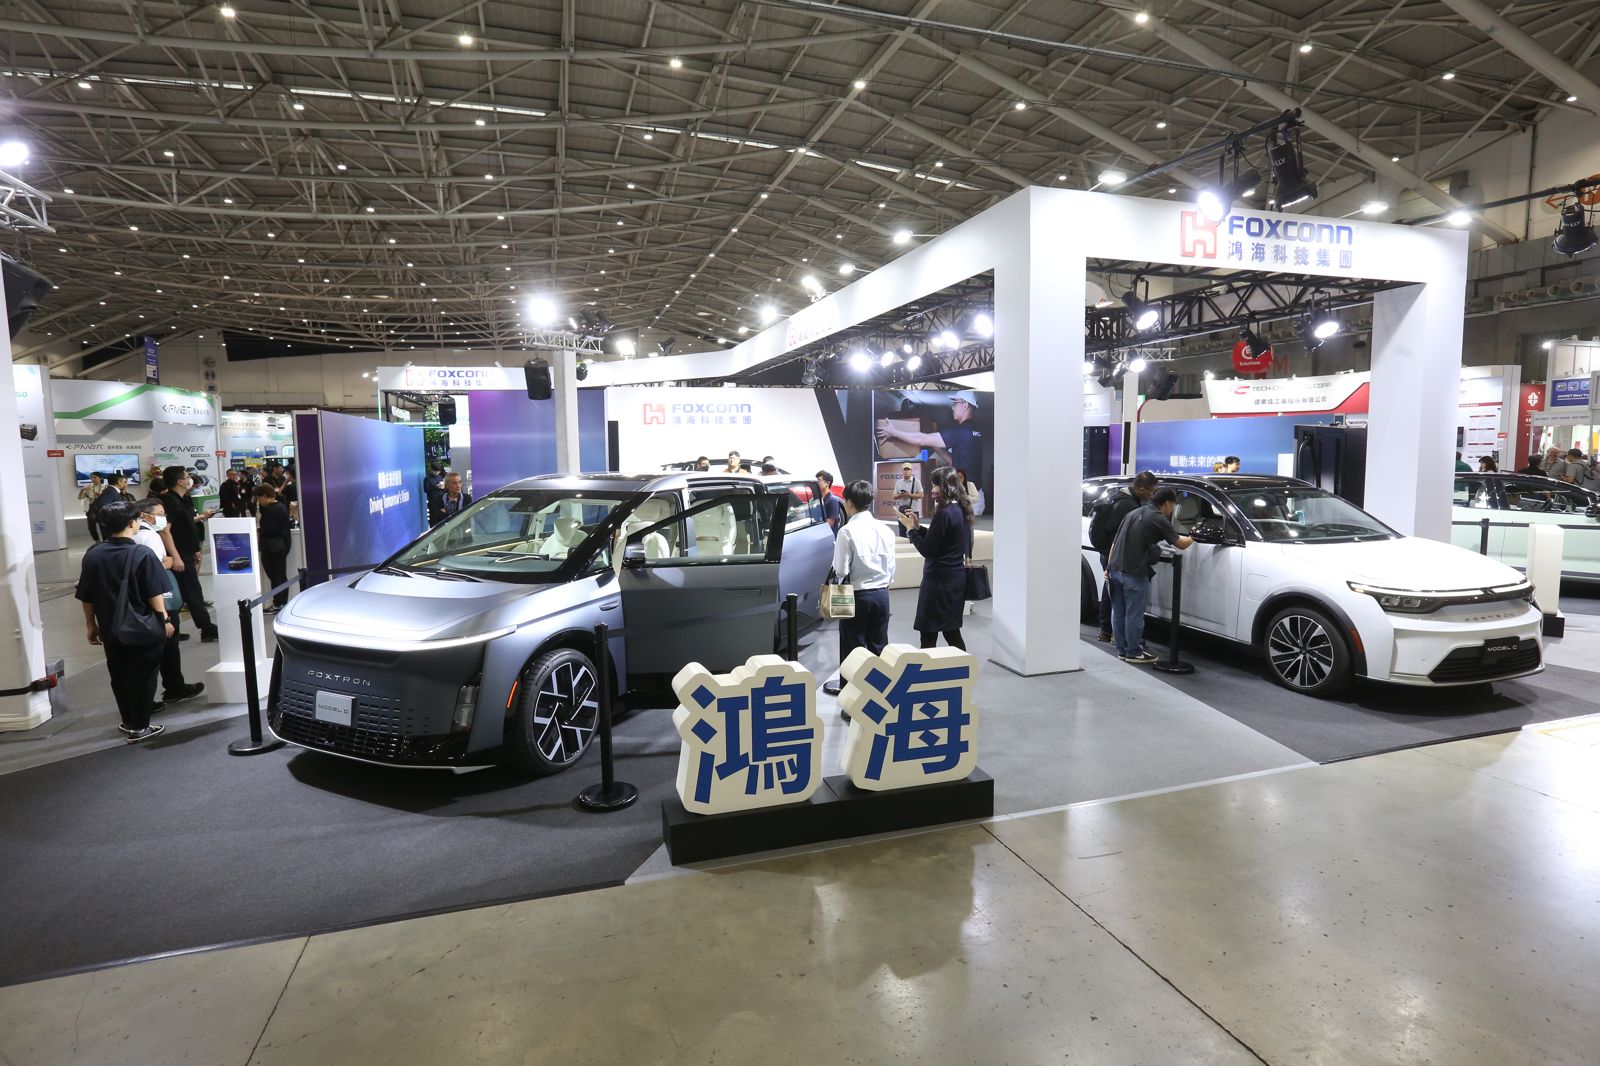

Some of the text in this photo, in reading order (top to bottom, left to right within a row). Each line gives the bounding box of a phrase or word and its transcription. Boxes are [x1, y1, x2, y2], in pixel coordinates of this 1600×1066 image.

[1228, 215, 1353, 245] FOXCONN
[1228, 240, 1352, 269] 鴻海科技集團
[672, 403, 752, 413] FOXCONN
[672, 415, 752, 424] 鴻海科技集團
[307, 670, 371, 686] FOXTRON
[318, 704, 342, 713] MODEL
[691, 663, 970, 804] 鴻海
